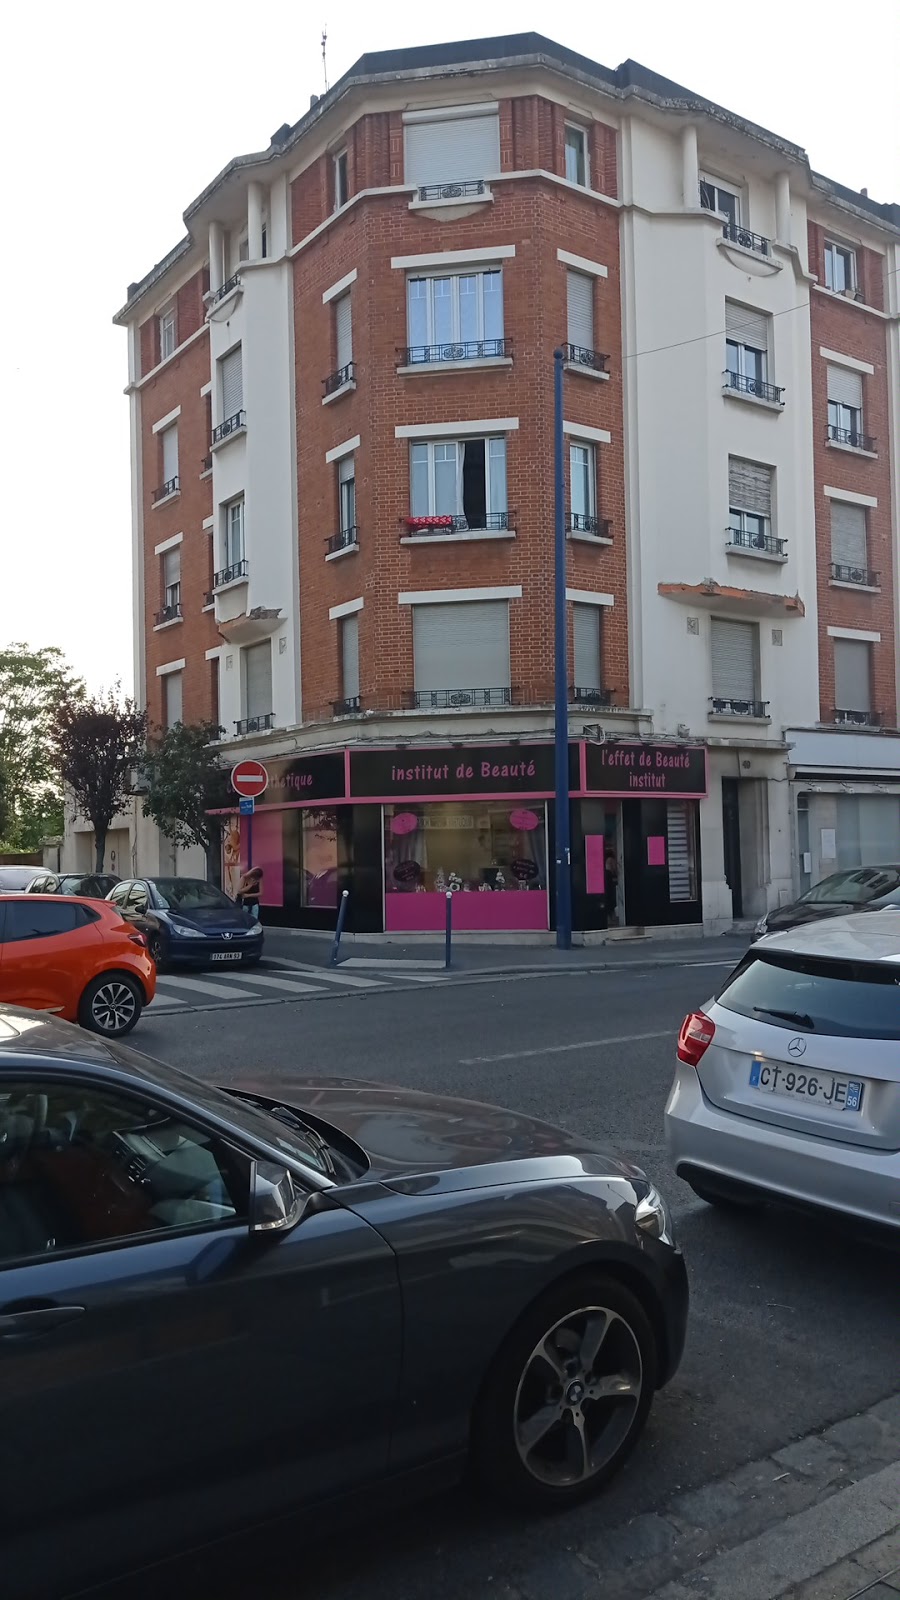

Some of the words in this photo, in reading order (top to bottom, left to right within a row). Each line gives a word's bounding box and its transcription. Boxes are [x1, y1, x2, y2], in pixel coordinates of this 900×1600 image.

[601, 749, 635, 766] l'effet
[639, 751, 652, 767] de
[655, 751, 690, 768] Beauté
[391, 765, 449, 780] institut
[455, 763, 474, 778] de
[480, 760, 536, 777] Beauté
[629, 771, 666, 788] institut
[760, 1066, 848, 1102] CT-926-JE
[846, 1095, 858, 1107] 56
